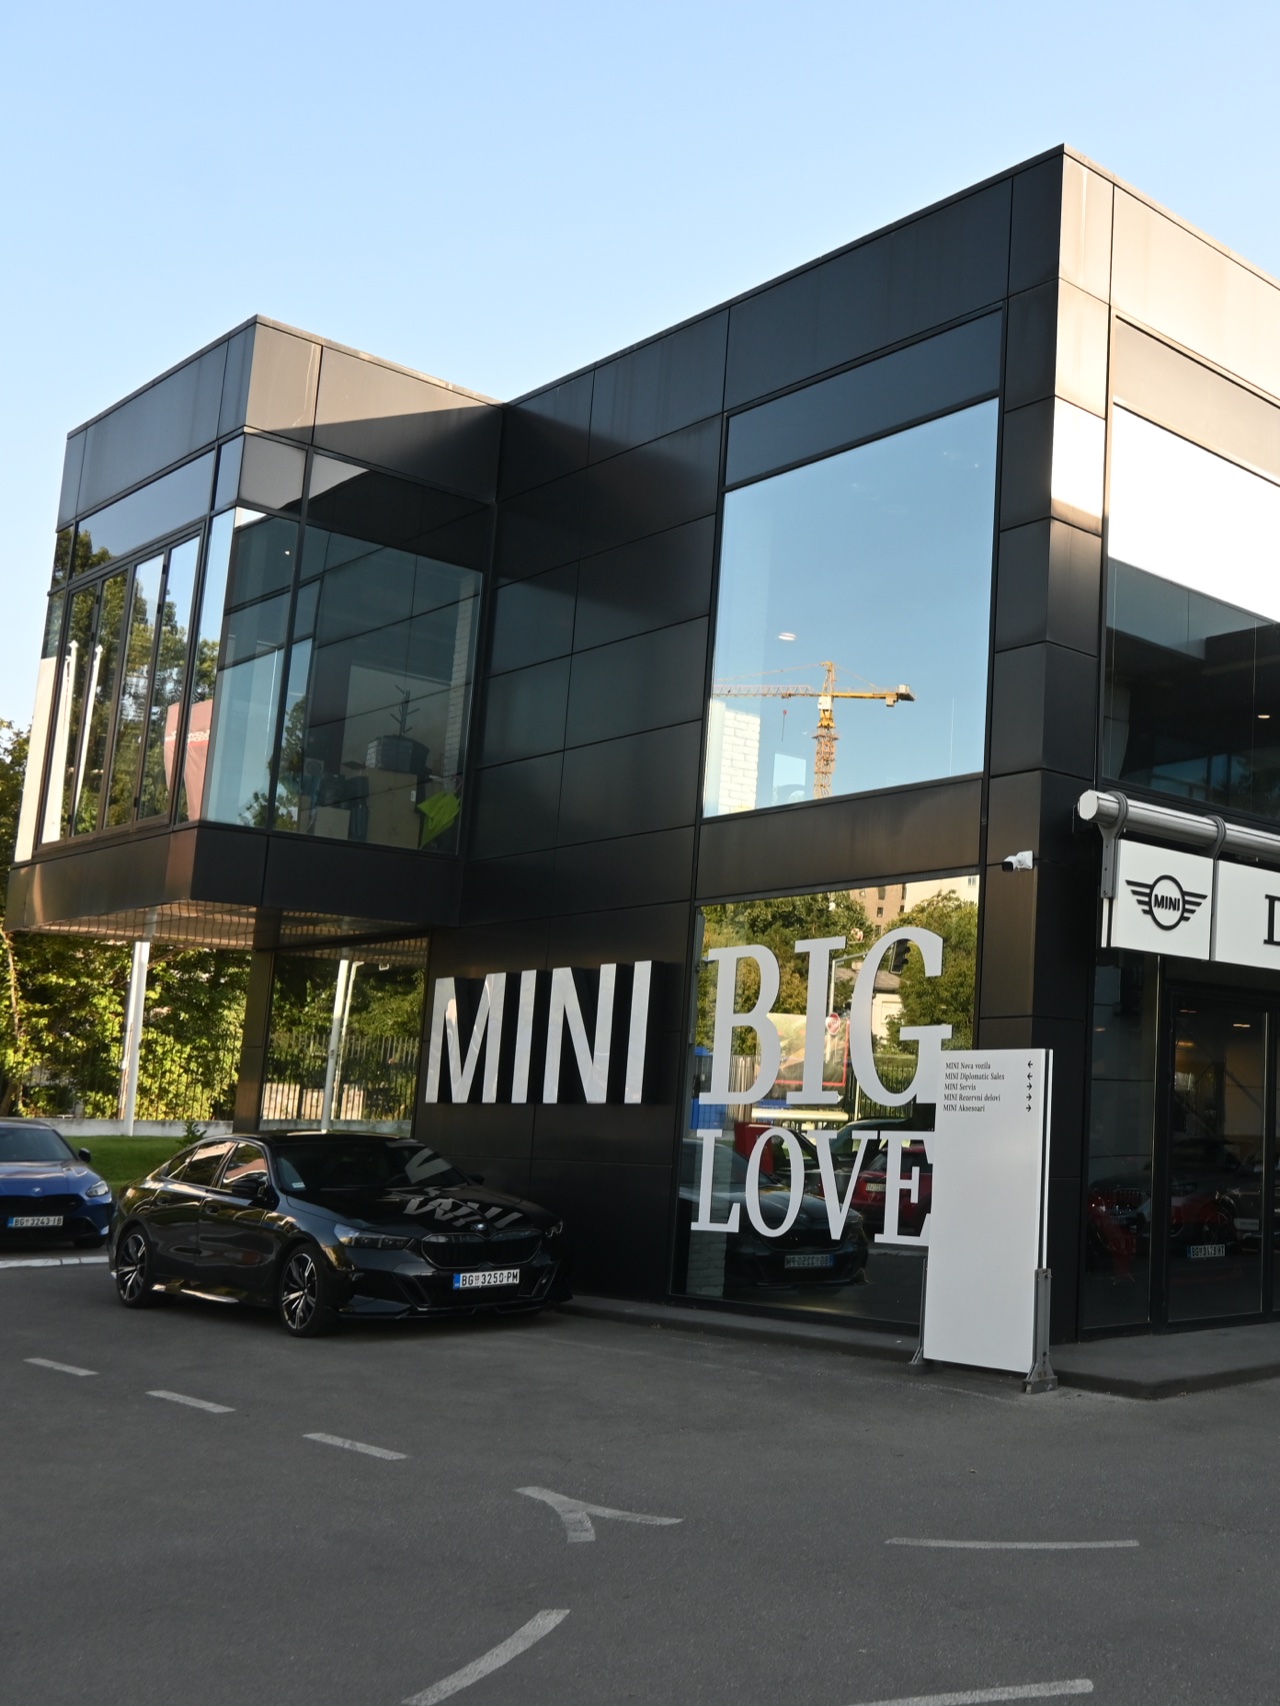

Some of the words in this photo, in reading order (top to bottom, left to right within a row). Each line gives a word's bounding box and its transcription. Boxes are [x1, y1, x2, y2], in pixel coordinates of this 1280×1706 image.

[1153, 892, 1181, 913] MINI
[699, 926, 953, 1107] BIG
[425, 960, 653, 1104] MINI
[945, 1062, 959, 1070] MINI
[960, 1062, 974, 1070] Nova
[975, 1061, 991, 1070] vozila
[945, 1072, 959, 1080] MINI
[960, 1072, 989, 1081] Diplomatic
[990, 1072, 1005, 1081] Sales
[944, 1083, 958, 1091] MINI
[959, 1083, 976, 1091] Servis
[943, 1093, 957, 1101] MINI
[958, 1093, 983, 1101] Rezervni
[983, 1093, 1001, 1102] delovi
[943, 1104, 957, 1112] MINI
[958, 1104, 985, 1112] Aksesoari
[691, 1127, 935, 1247] LOVE
[461, 1274, 474, 1286] BG
